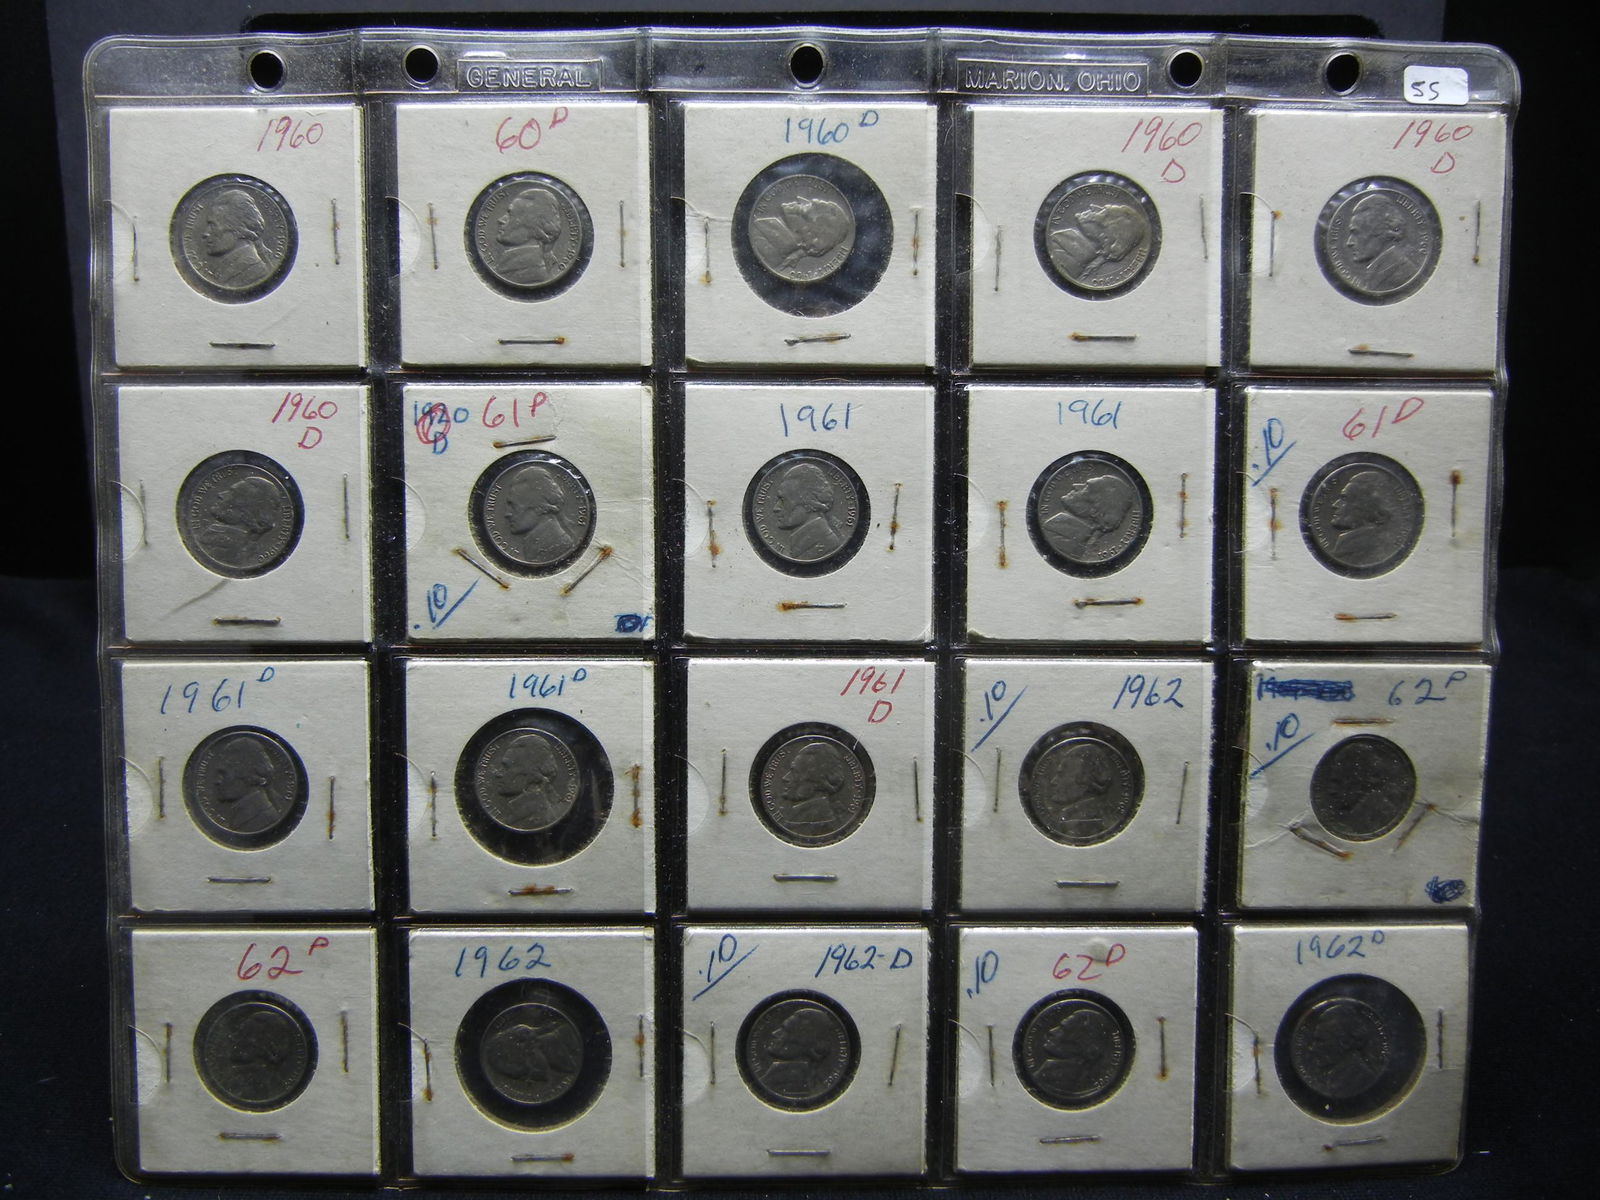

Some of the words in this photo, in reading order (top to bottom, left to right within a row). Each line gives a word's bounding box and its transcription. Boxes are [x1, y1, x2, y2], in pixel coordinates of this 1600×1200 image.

[466, 65, 592, 88] GENERAL
[1077, 70, 1141, 92] OHIO
[257, 115, 324, 152] 1960
[1121, 115, 1203, 154] 1960
[1392, 119, 1474, 150] 1960
[1160, 158, 1187, 184] D
[1429, 151, 1456, 174] D
[271, 391, 338, 424] 1960
[779, 402, 852, 438] 1961
[1057, 398, 1123, 430] 1961
[297, 426, 323, 450] D
[839, 665, 906, 697] 1961
[1112, 674, 1185, 710] 1962
[867, 699, 893, 724] D
[454, 942, 552, 979] 1962
